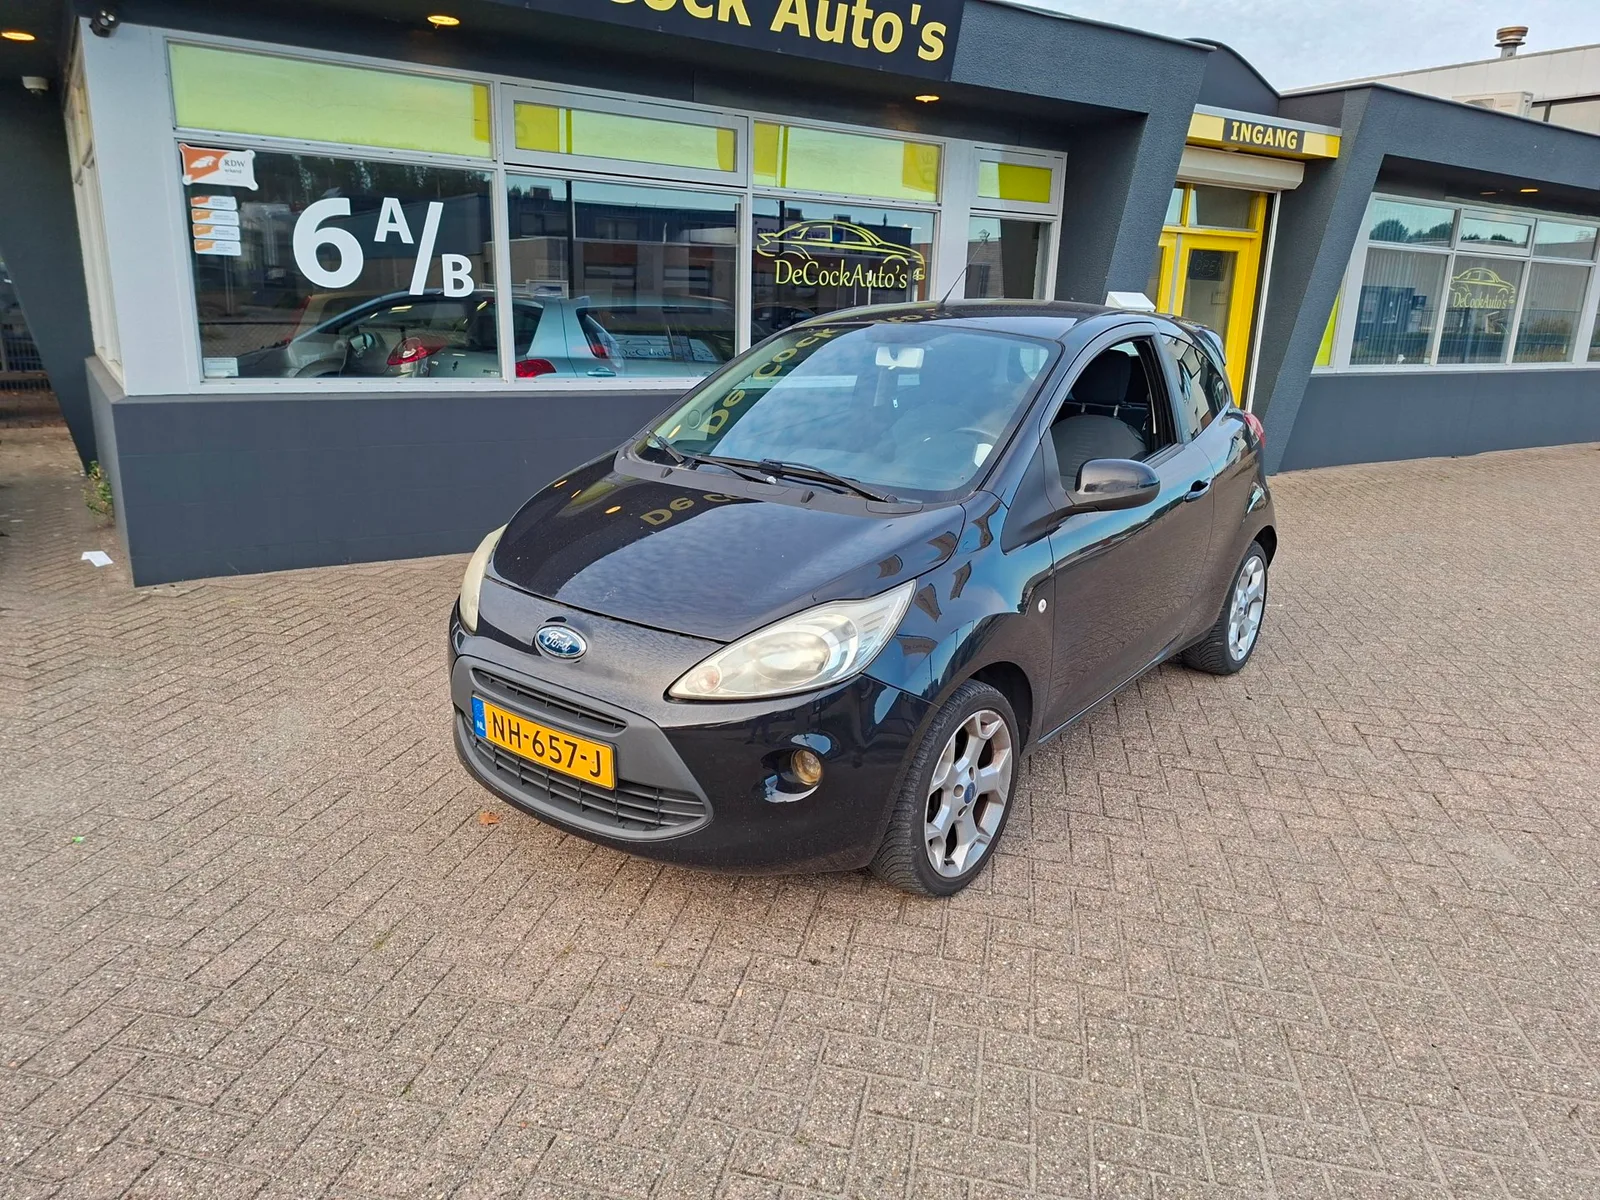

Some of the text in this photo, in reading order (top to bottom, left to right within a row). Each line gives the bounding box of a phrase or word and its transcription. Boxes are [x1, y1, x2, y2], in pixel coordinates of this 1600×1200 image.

[770, 0, 947, 61] Auto's
[1231, 121, 1298, 149] INGANG
[224, 159, 246, 167] RDW
[292, 197, 364, 289] 6
[544, 631, 572, 652] Ford
[476, 719, 486, 731] NL
[491, 711, 602, 778] NH-657-J
